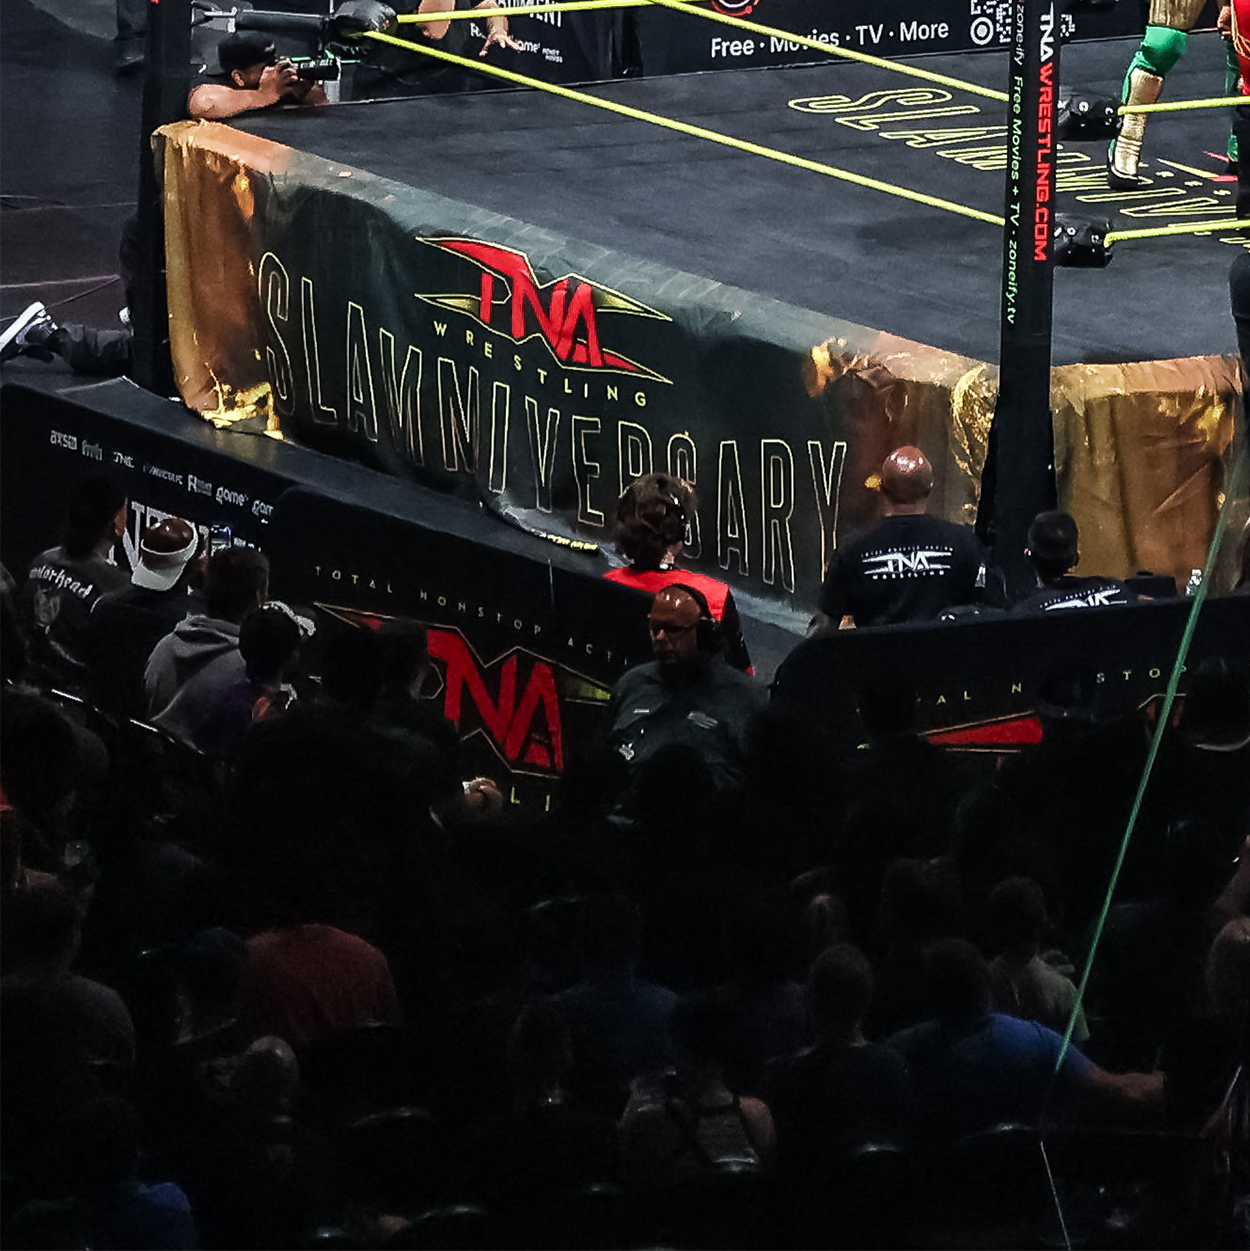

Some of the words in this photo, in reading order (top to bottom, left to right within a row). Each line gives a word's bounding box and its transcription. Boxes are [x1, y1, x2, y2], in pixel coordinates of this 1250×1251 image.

[711, 37, 754, 58] Free
[771, 28, 840, 54] Moies
[855, 23, 884, 46] TV
[899, 20, 950, 42] More
[1013, 75, 1024, 114] Free
[1010, 118, 1022, 180] Movies
[1008, 202, 1020, 225] TV
[437, 238, 640, 370] TNA
[1003, 238, 1018, 324] zoneify.tv
[433, 320, 648, 408] WRESTLING
[315, 566, 394, 594] TOTAL
[420, 589, 542, 637] NONSTOP
